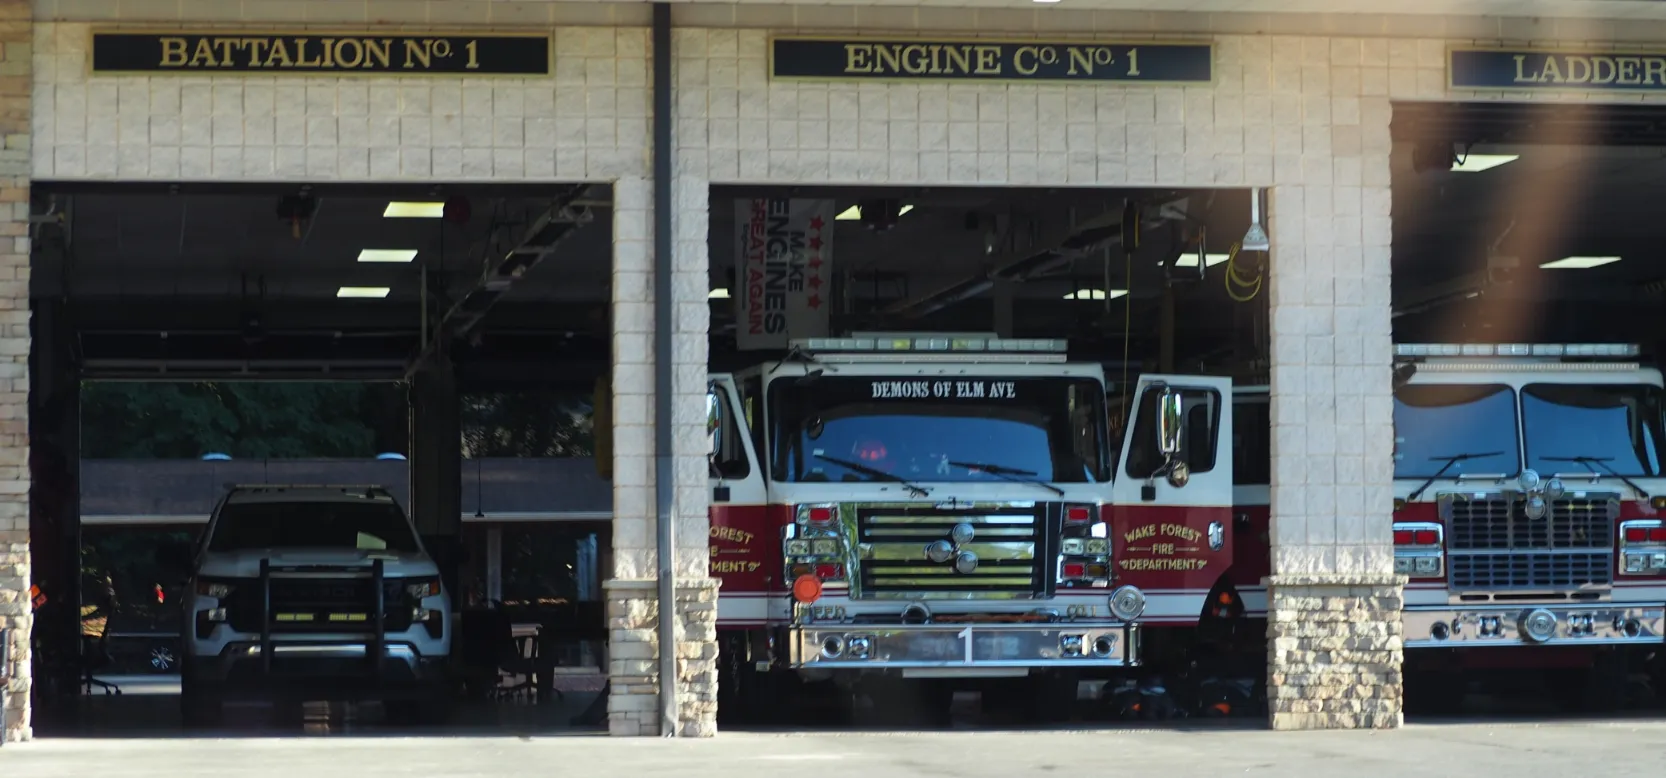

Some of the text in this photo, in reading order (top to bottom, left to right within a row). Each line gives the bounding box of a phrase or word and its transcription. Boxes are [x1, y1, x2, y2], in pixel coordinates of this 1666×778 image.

[159, 37, 392, 68] BATTALION
[465, 40, 480, 69] 1
[843, 43, 1001, 75] ENGINE
[1126, 48, 1141, 77] 1
[1513, 54, 1666, 85] LADDER
[764, 198, 790, 335] ENGINES
[789, 230, 805, 292] MAKE
[748, 267, 763, 335] AGAIN
[871, 381, 1016, 398] DEMONS OF ELM AVE
[709, 526, 754, 545] OREST
[1124, 523, 1203, 543] WAKE FOREST
[1129, 558, 1197, 571] DEPARTMENT
[1152, 543, 1175, 555] FIRE
[957, 625, 974, 665] 1
